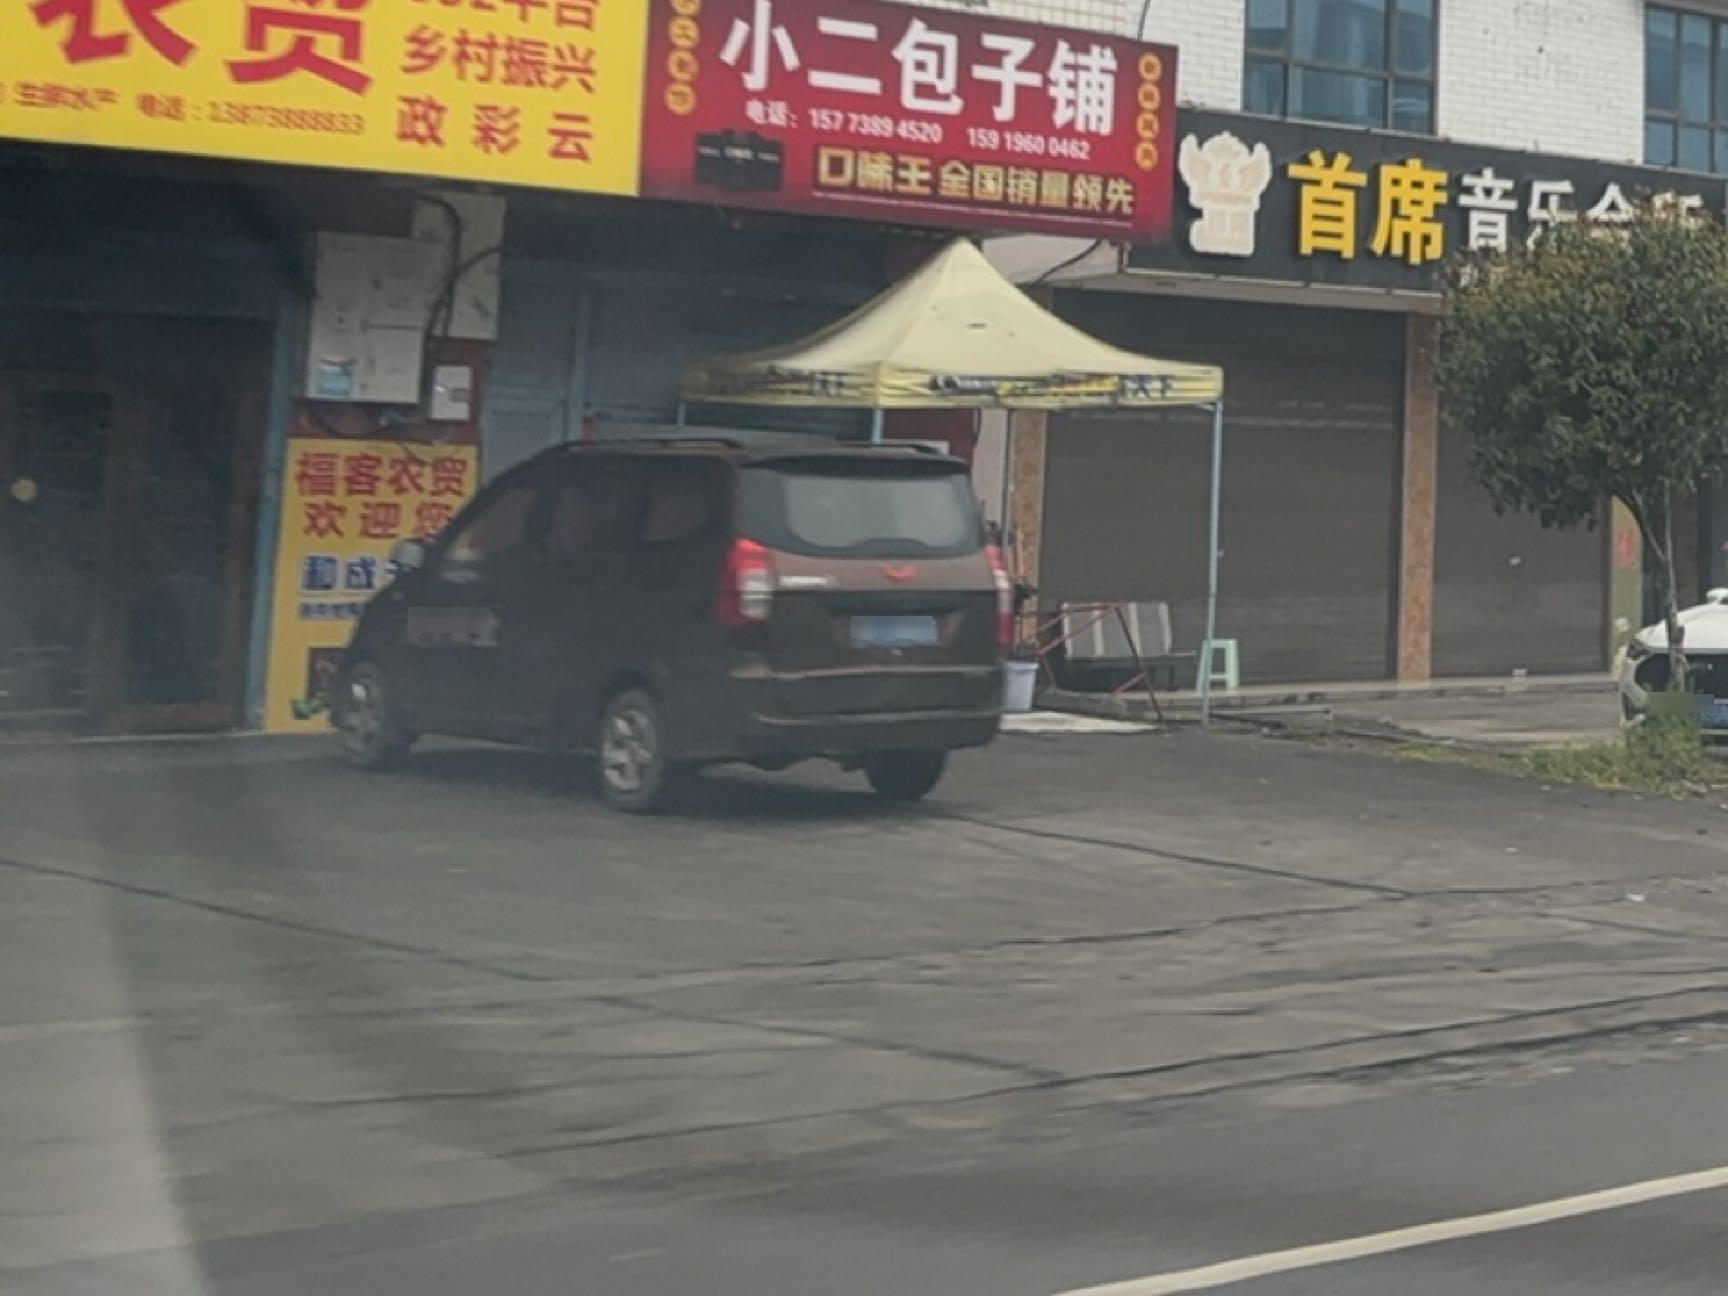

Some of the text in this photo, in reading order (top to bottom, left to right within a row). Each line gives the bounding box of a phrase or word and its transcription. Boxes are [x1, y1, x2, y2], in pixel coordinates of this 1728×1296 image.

[400, 26, 598, 95] 乡村振兴
[395, 95, 594, 164] 政彩云
[817, 146, 1135, 216] 口味王 全国销量领先
[296, 452, 467, 500] 福客农贸
